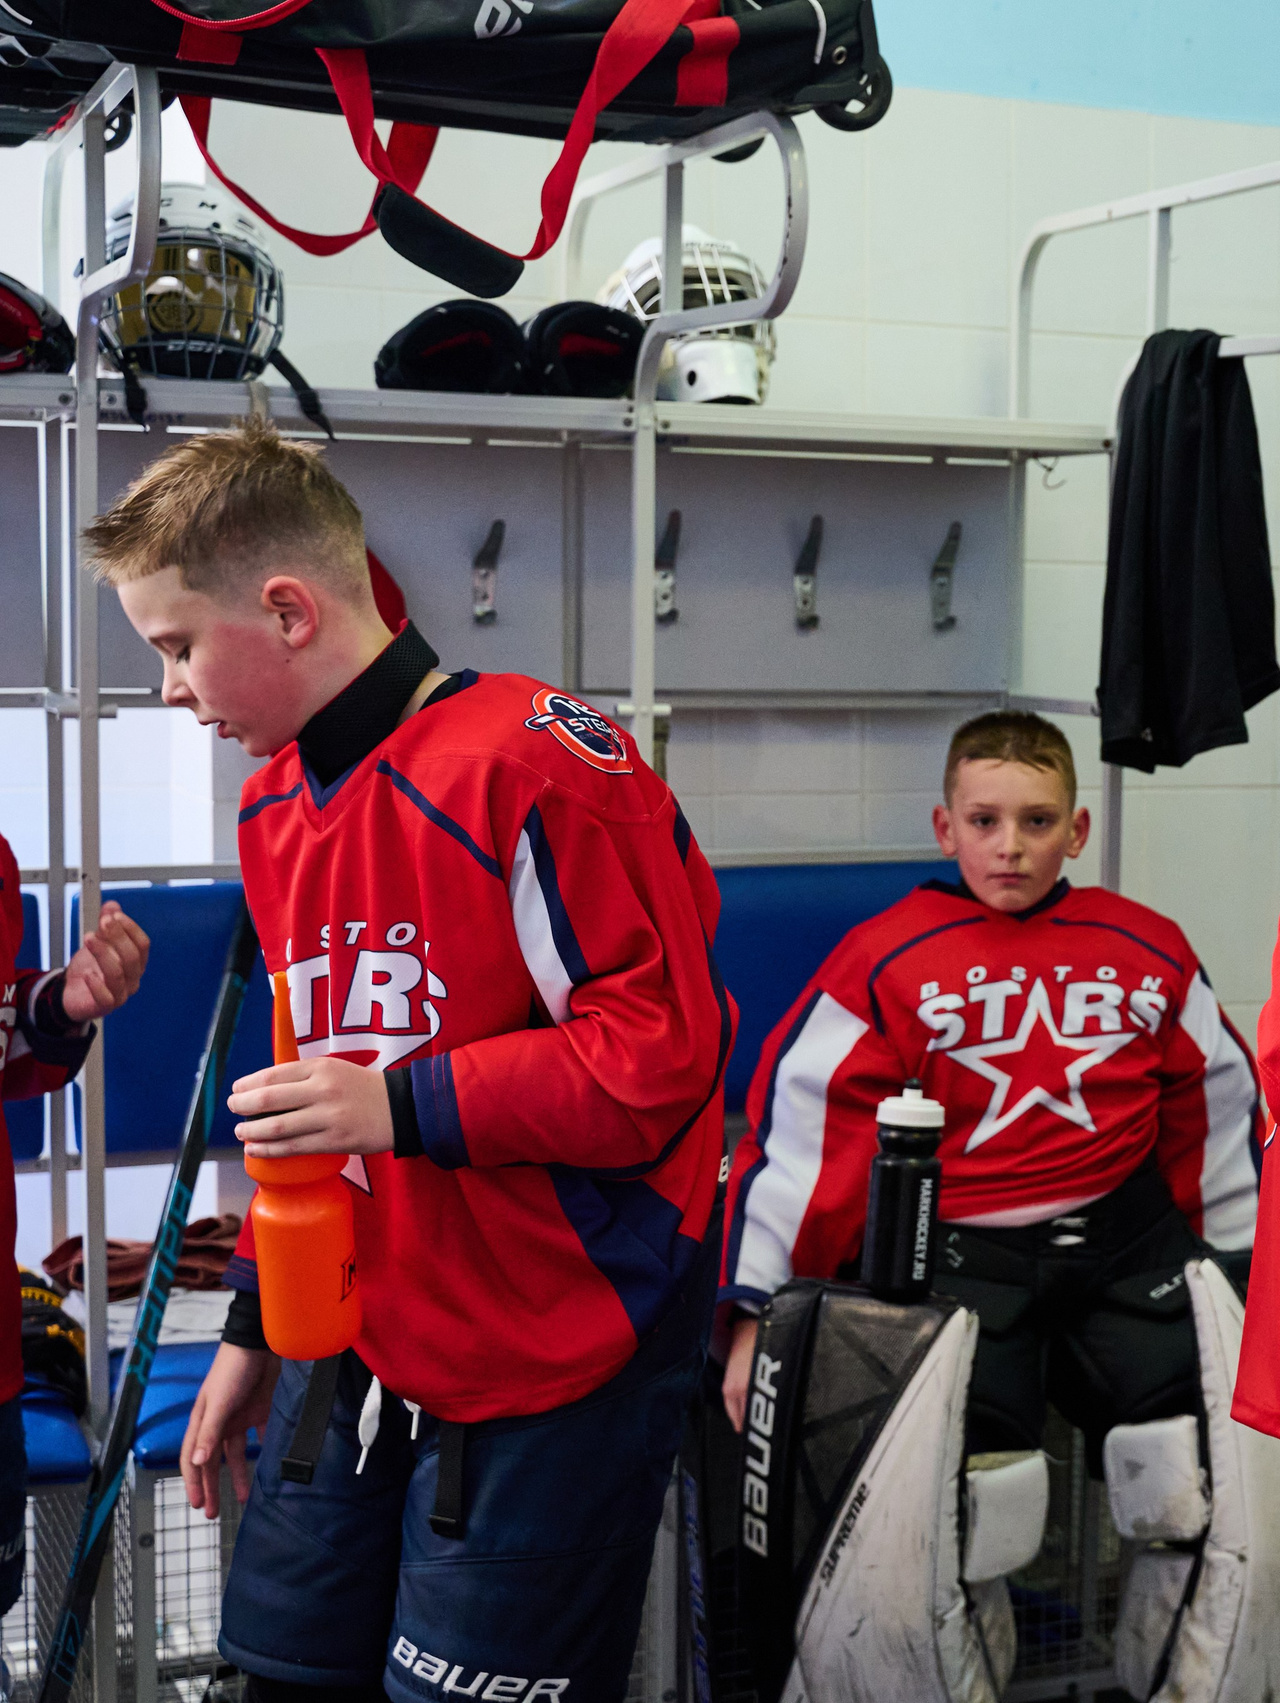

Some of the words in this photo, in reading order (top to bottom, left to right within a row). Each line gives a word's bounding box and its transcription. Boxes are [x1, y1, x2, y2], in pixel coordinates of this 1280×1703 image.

[917, 976, 1168, 1052] STARS
[920, 965, 1163, 1000] BOSTON
[912, 1178, 934, 1281] MARKHOCKEY.RU
[127, 1178, 193, 1387] BAUER
[743, 1352, 782, 1558] BAUER
[818, 1480, 871, 1588] SUPREME
[393, 1635, 570, 1703] BAUER
